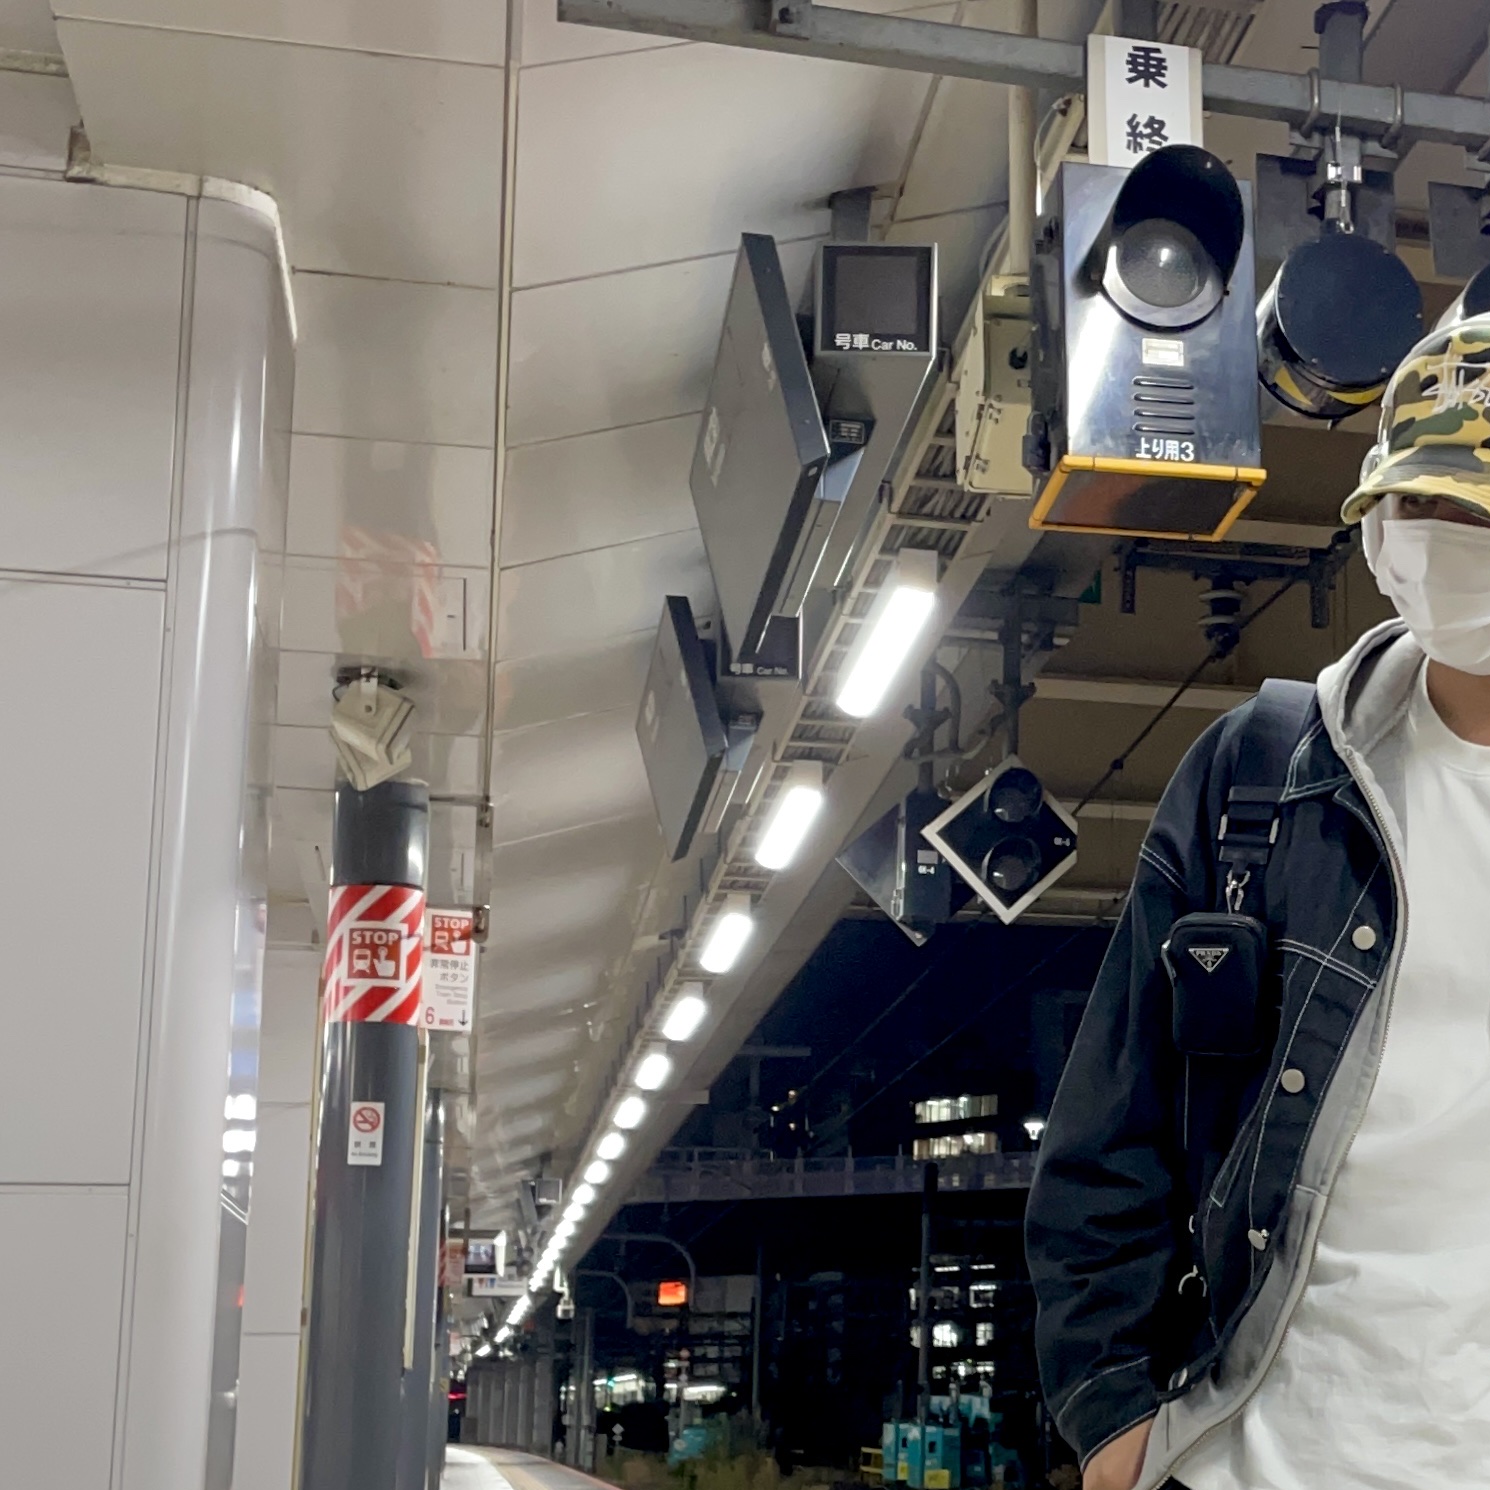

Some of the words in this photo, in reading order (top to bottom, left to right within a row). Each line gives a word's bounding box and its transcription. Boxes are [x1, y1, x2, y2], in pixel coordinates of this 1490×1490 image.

[834, 333, 870, 350] 号車
[871, 339, 894, 350] Car
[896, 340, 918, 350] No.
[1135, 437, 1195, 462] 上り用3
[434, 916, 470, 928] STOP
[351, 930, 400, 945] STOP
[425, 1006, 435, 1025] 6
